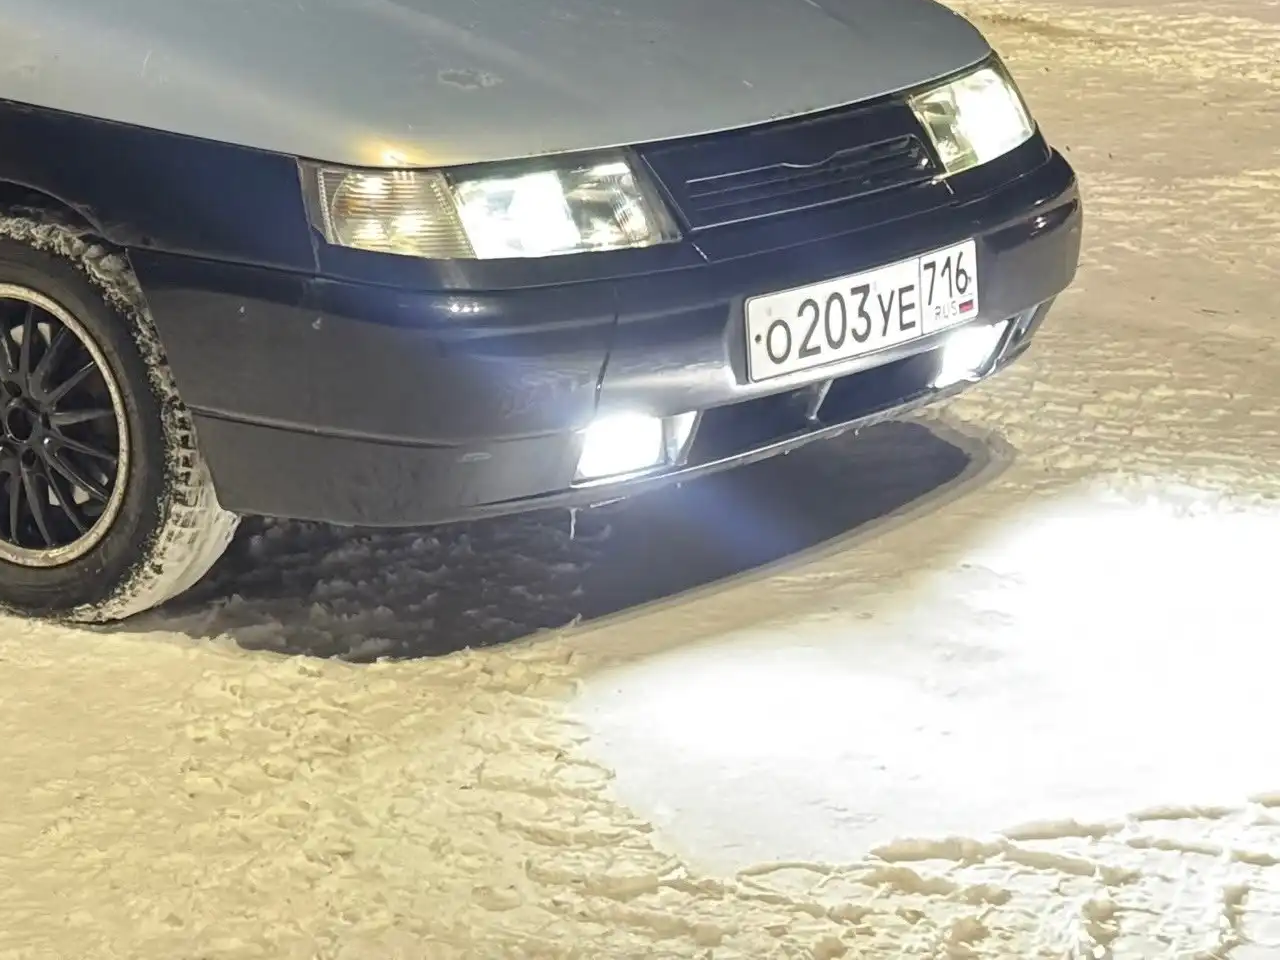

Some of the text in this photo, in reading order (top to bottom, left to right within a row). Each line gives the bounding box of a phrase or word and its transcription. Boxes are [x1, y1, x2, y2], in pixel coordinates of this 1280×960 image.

[766, 251, 970, 364] О203УЕ 716
[935, 300, 958, 321] RUS
